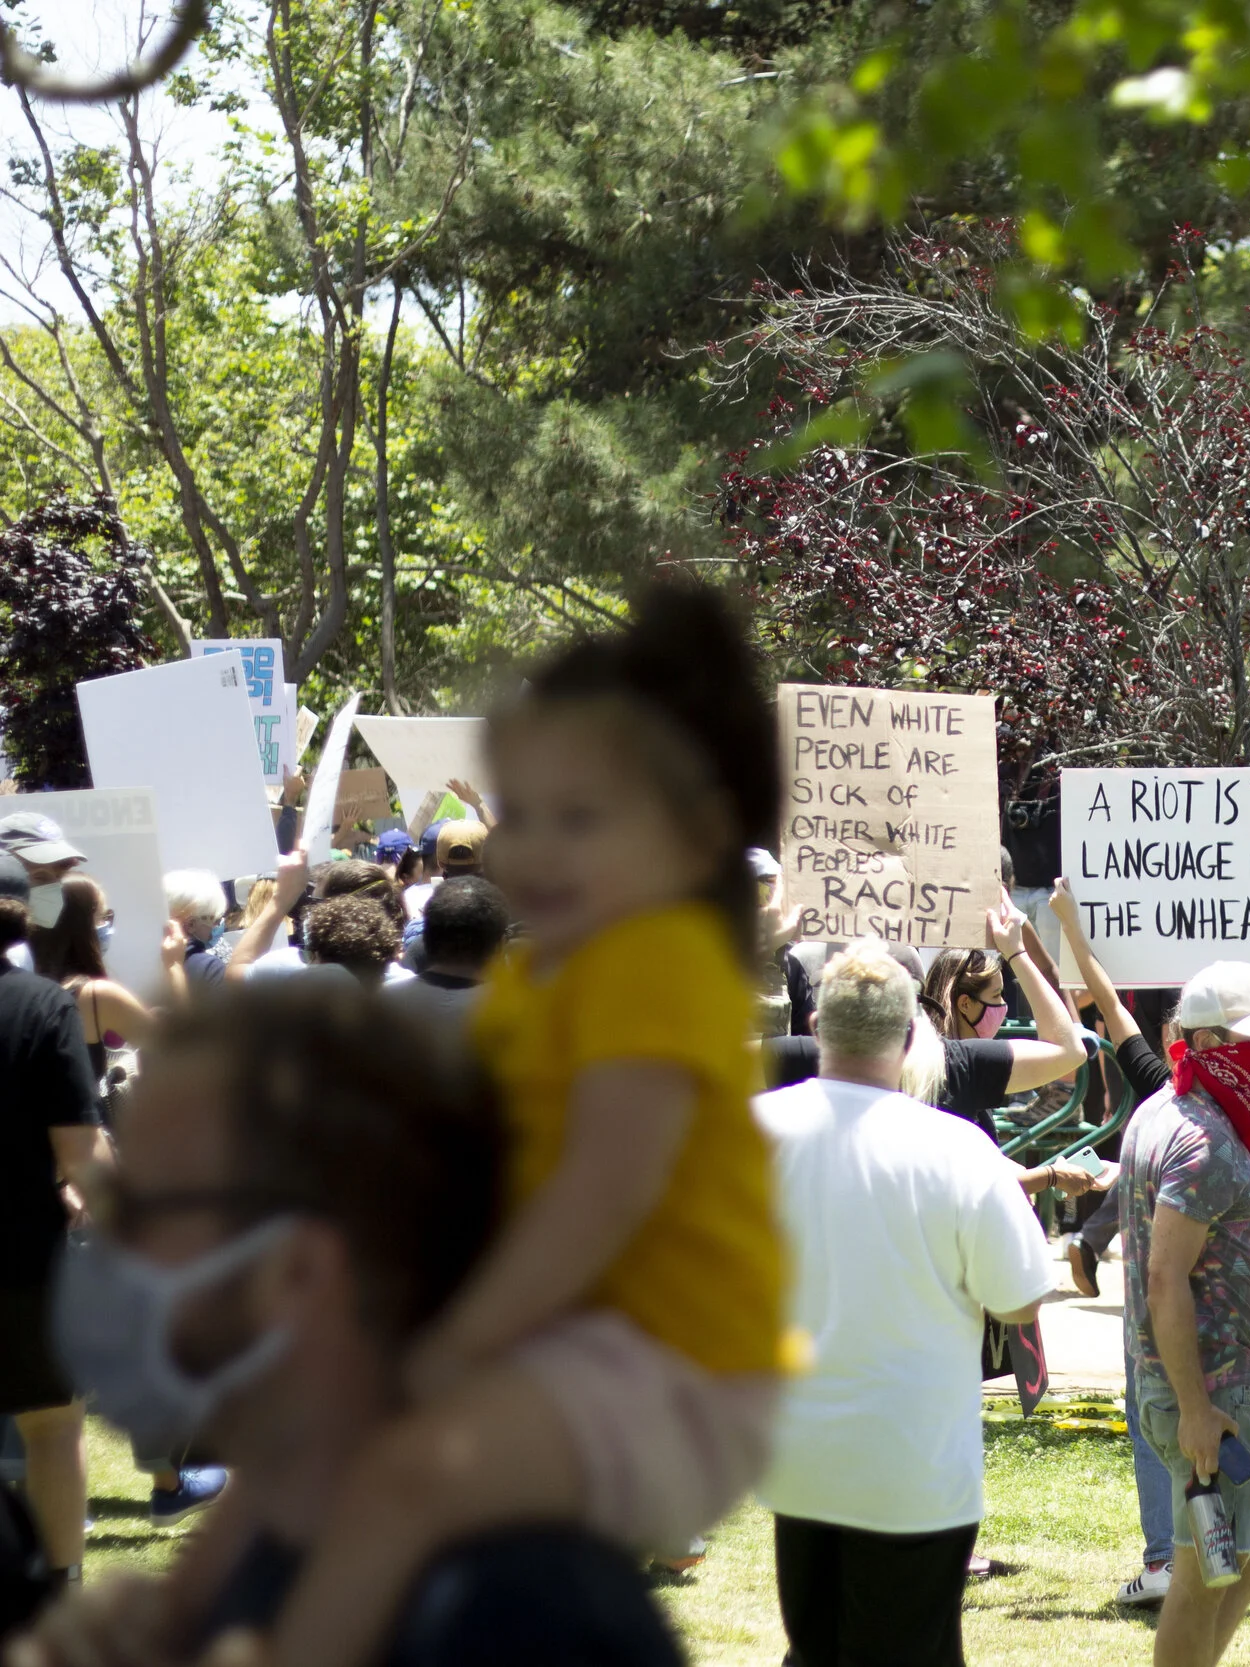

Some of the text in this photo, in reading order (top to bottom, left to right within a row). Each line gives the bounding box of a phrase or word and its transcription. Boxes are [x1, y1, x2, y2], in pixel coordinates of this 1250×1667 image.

[797, 691, 964, 735] EVEN WHITE
[795, 736, 959, 776] PEOPLE ARE
[792, 778, 868, 806] SICK
[1088, 782, 1111, 822] A
[1215, 778, 1240, 825] IS
[791, 815, 958, 850] OTHER WHITE
[1082, 838, 1235, 881] LANGUAGE
[821, 876, 971, 915] RACIST
[1080, 901, 1142, 939] THE
